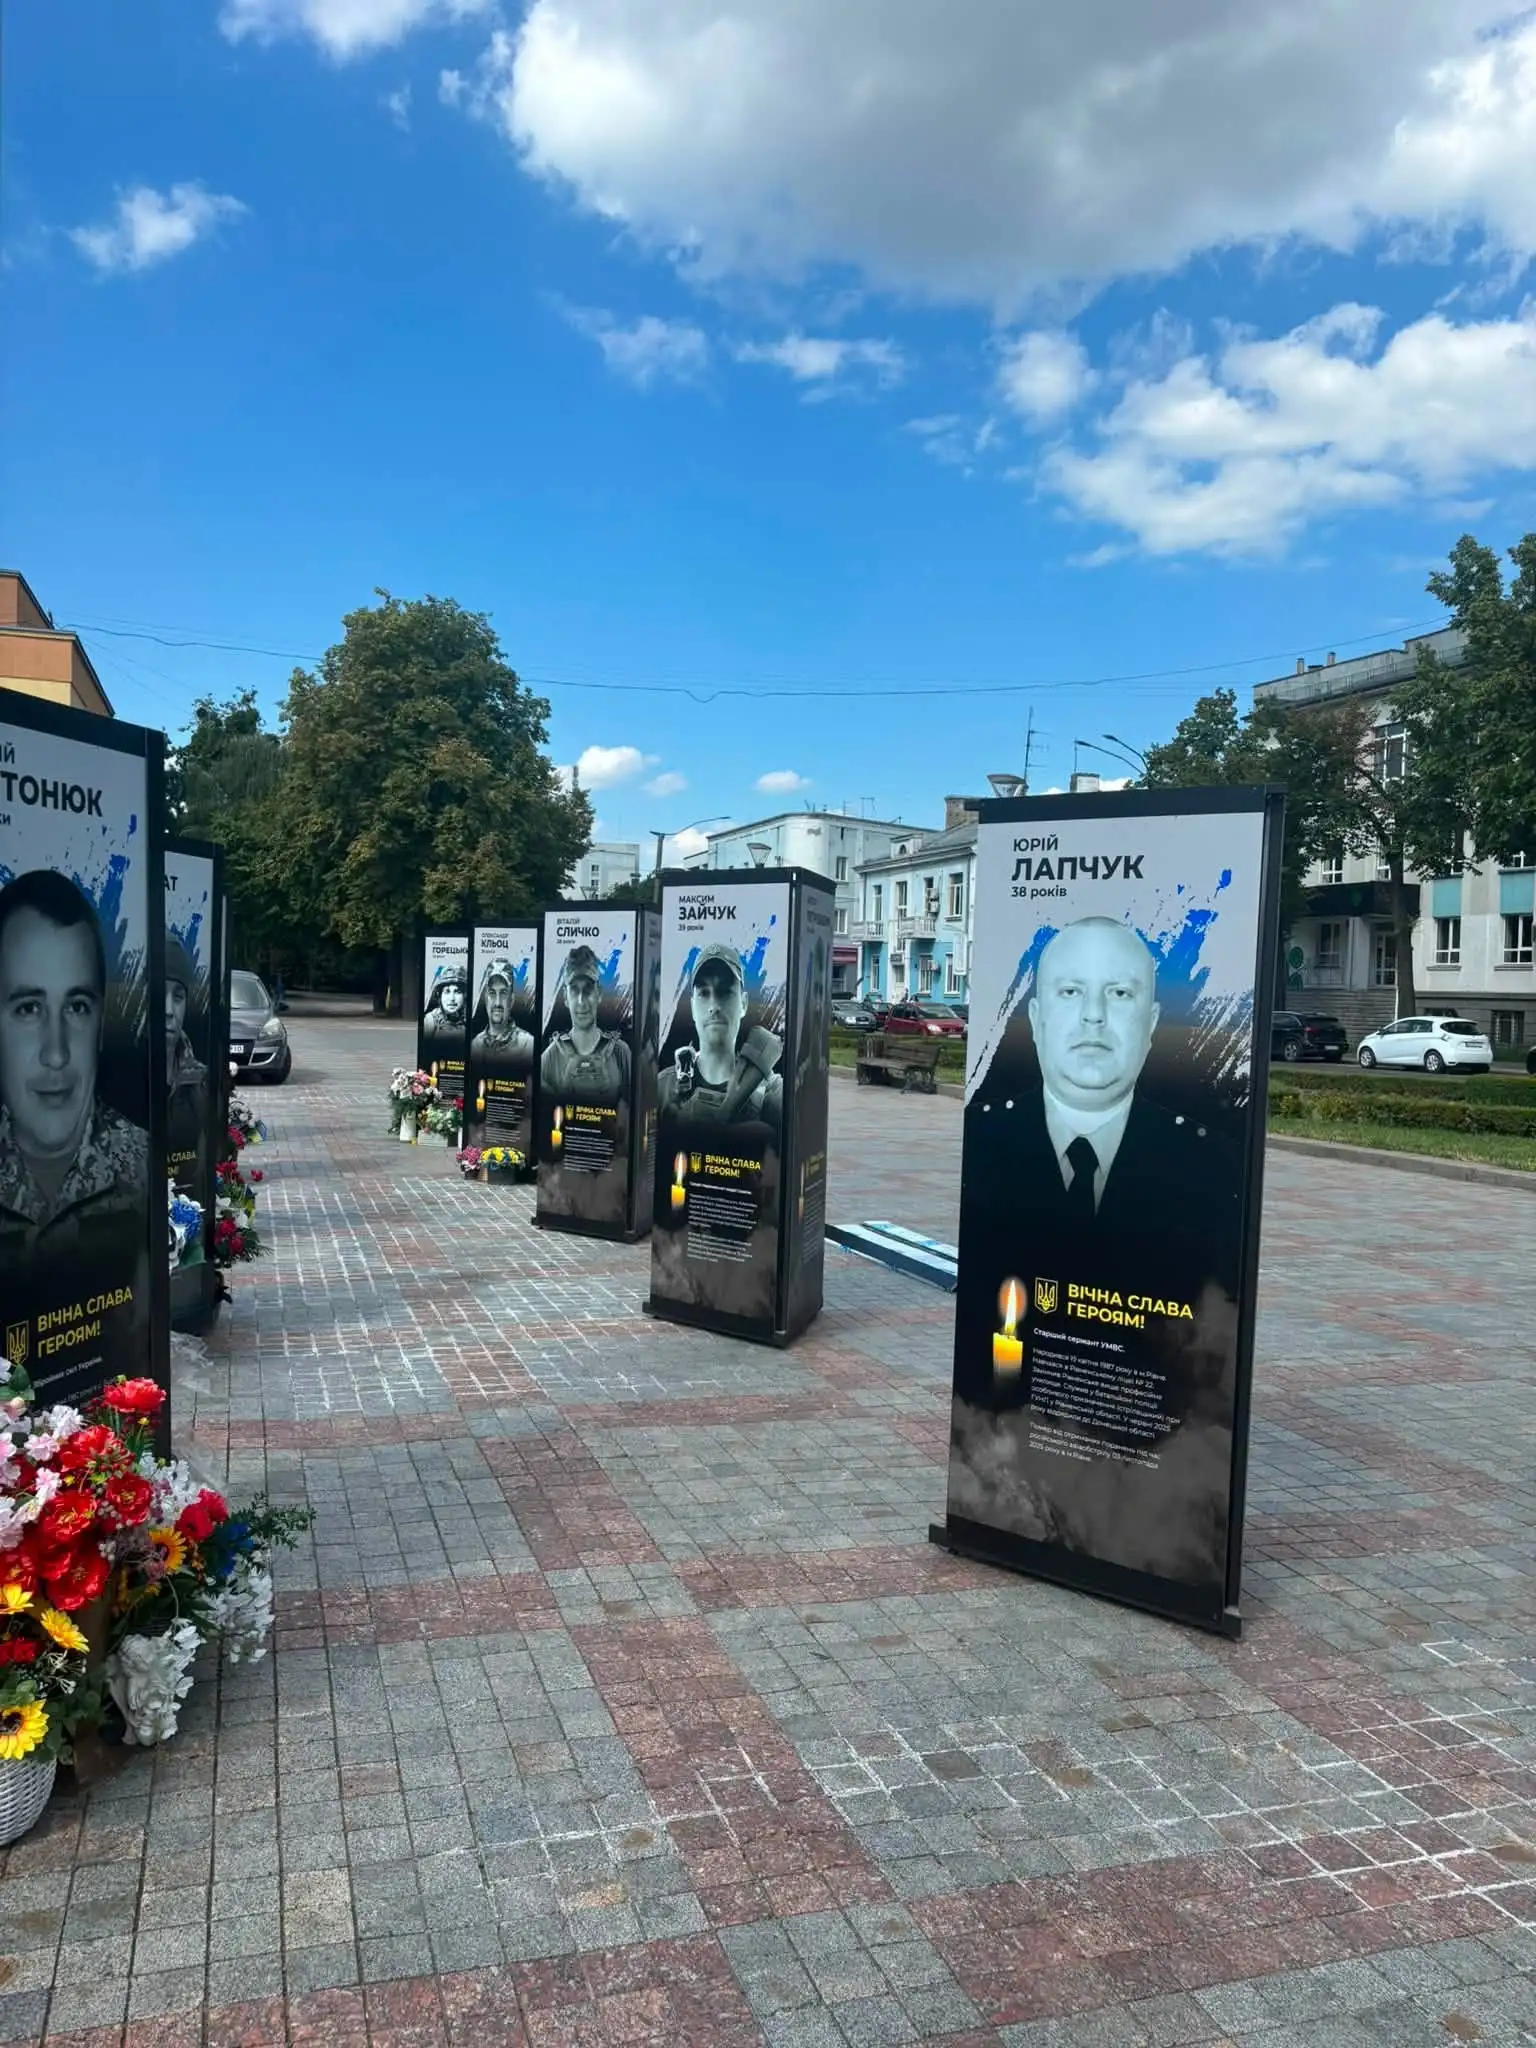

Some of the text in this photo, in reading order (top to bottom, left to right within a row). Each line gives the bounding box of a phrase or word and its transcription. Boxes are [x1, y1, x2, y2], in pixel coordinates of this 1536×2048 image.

[1013, 834, 1058, 852] ЮРІЙ
[1011, 855, 1144, 881] ЛАПЧУК
[678, 895, 715, 905] МАКСИМ
[1011, 885, 1067, 900] 38 років
[678, 902, 737, 920] ЗАЙЧУК
[556, 926, 600, 937] СЛИЧКО
[705, 1155, 761, 1171] ВІЧНА СЛАВА
[705, 1166, 740, 1178] ГЕРОЯМ!
[37, 1286, 133, 1332] ВІЧНА СЛАВА
[1068, 1283, 1193, 1320] ВІЧНА СЛАВА
[1067, 1302, 1145, 1329] ГЕРОЯМ!
[37, 1319, 101, 1358] ГЕРОЯМ!
